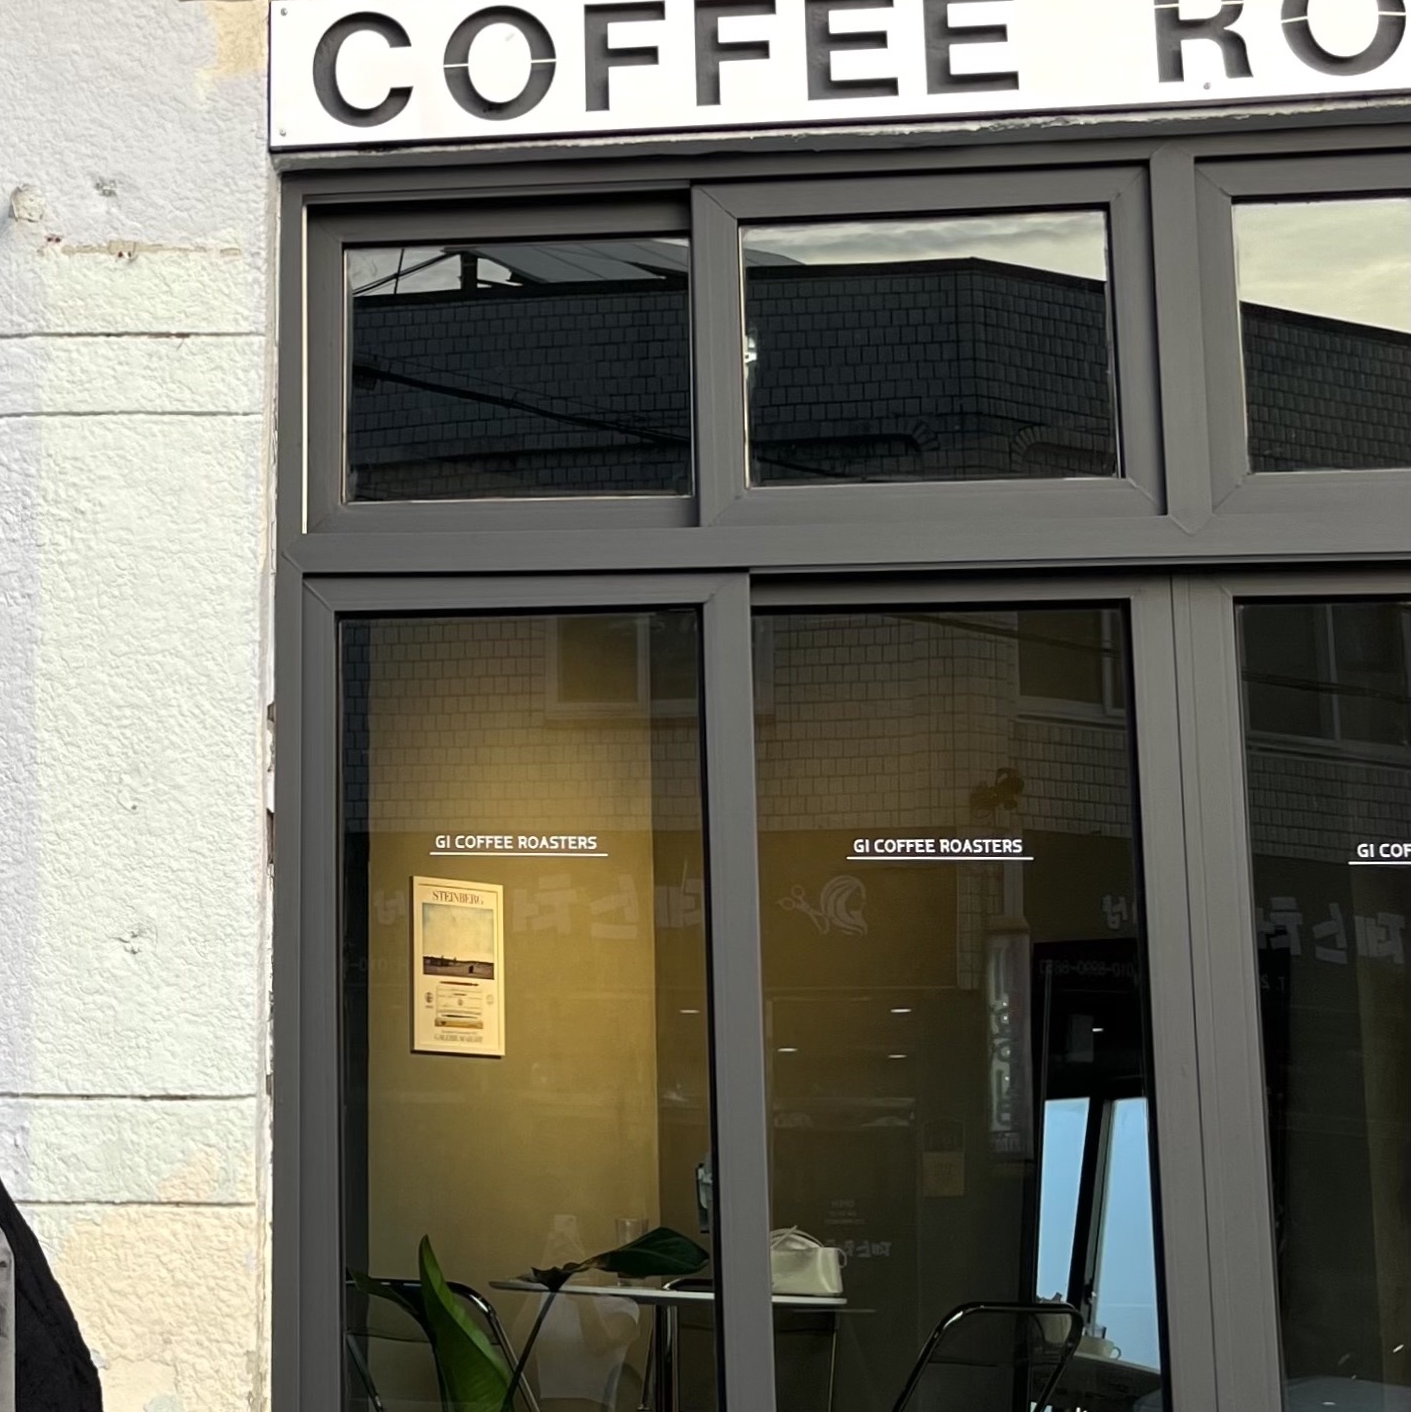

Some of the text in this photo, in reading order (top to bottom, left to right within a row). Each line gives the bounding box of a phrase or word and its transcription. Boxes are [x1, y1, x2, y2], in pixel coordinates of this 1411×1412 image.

[312, 0, 1407, 128] COFFEE RO
[435, 835, 598, 850] GI COFFEE ROASTERS
[853, 839, 1023, 853] GI COFFEE ROASTERS
[1357, 843, 1375, 858] GI
[432, 891, 484, 905] STEINBERG
